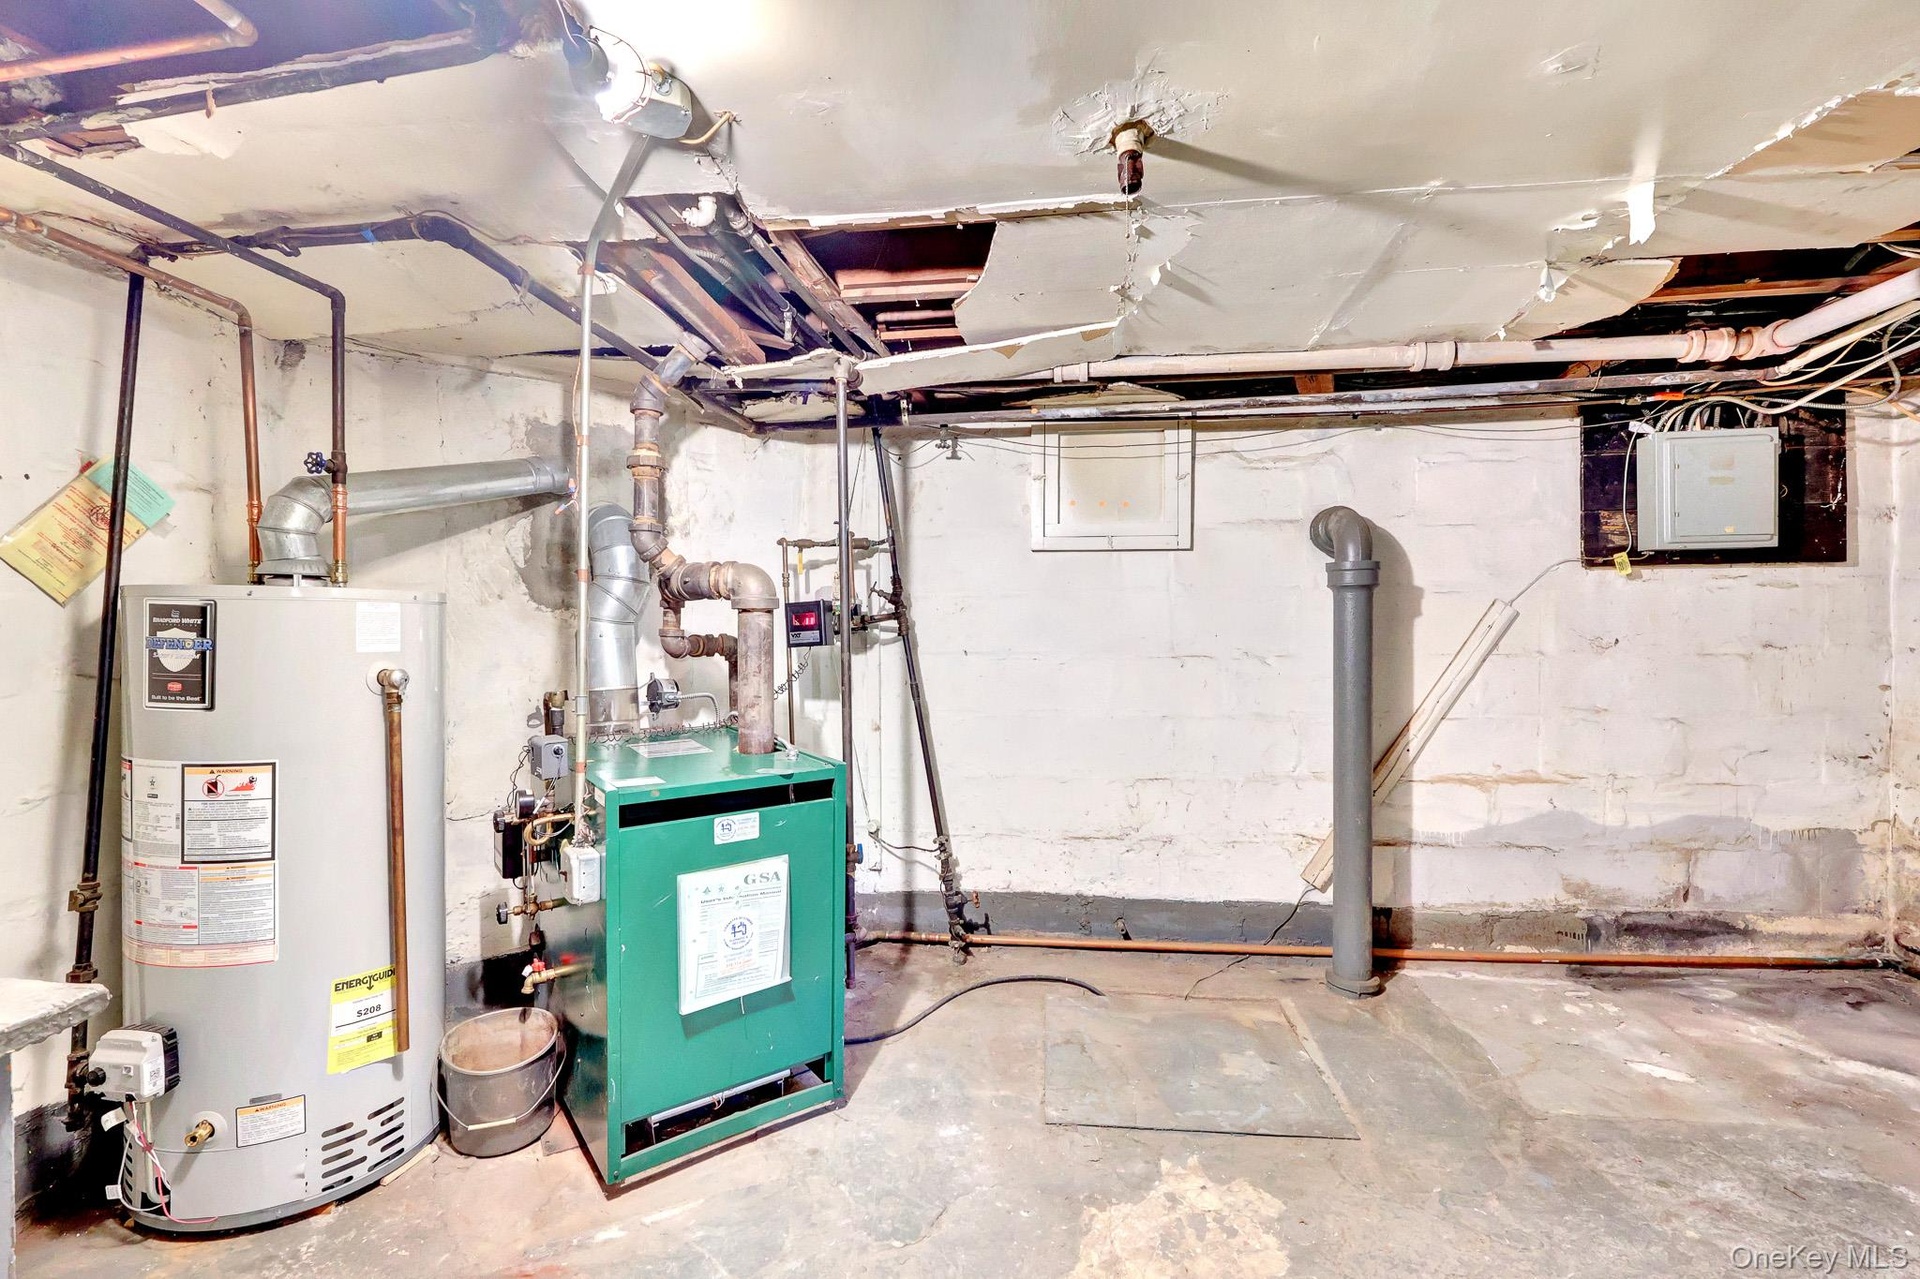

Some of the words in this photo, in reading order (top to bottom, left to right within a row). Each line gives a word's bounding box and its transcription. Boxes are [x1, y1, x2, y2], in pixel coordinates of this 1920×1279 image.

[181, 617, 203, 625] WHITE
[146, 637, 213, 650] DEFENDER
[743, 870, 781, 886] GSA
[259, 1101, 287, 1111] WARNING
